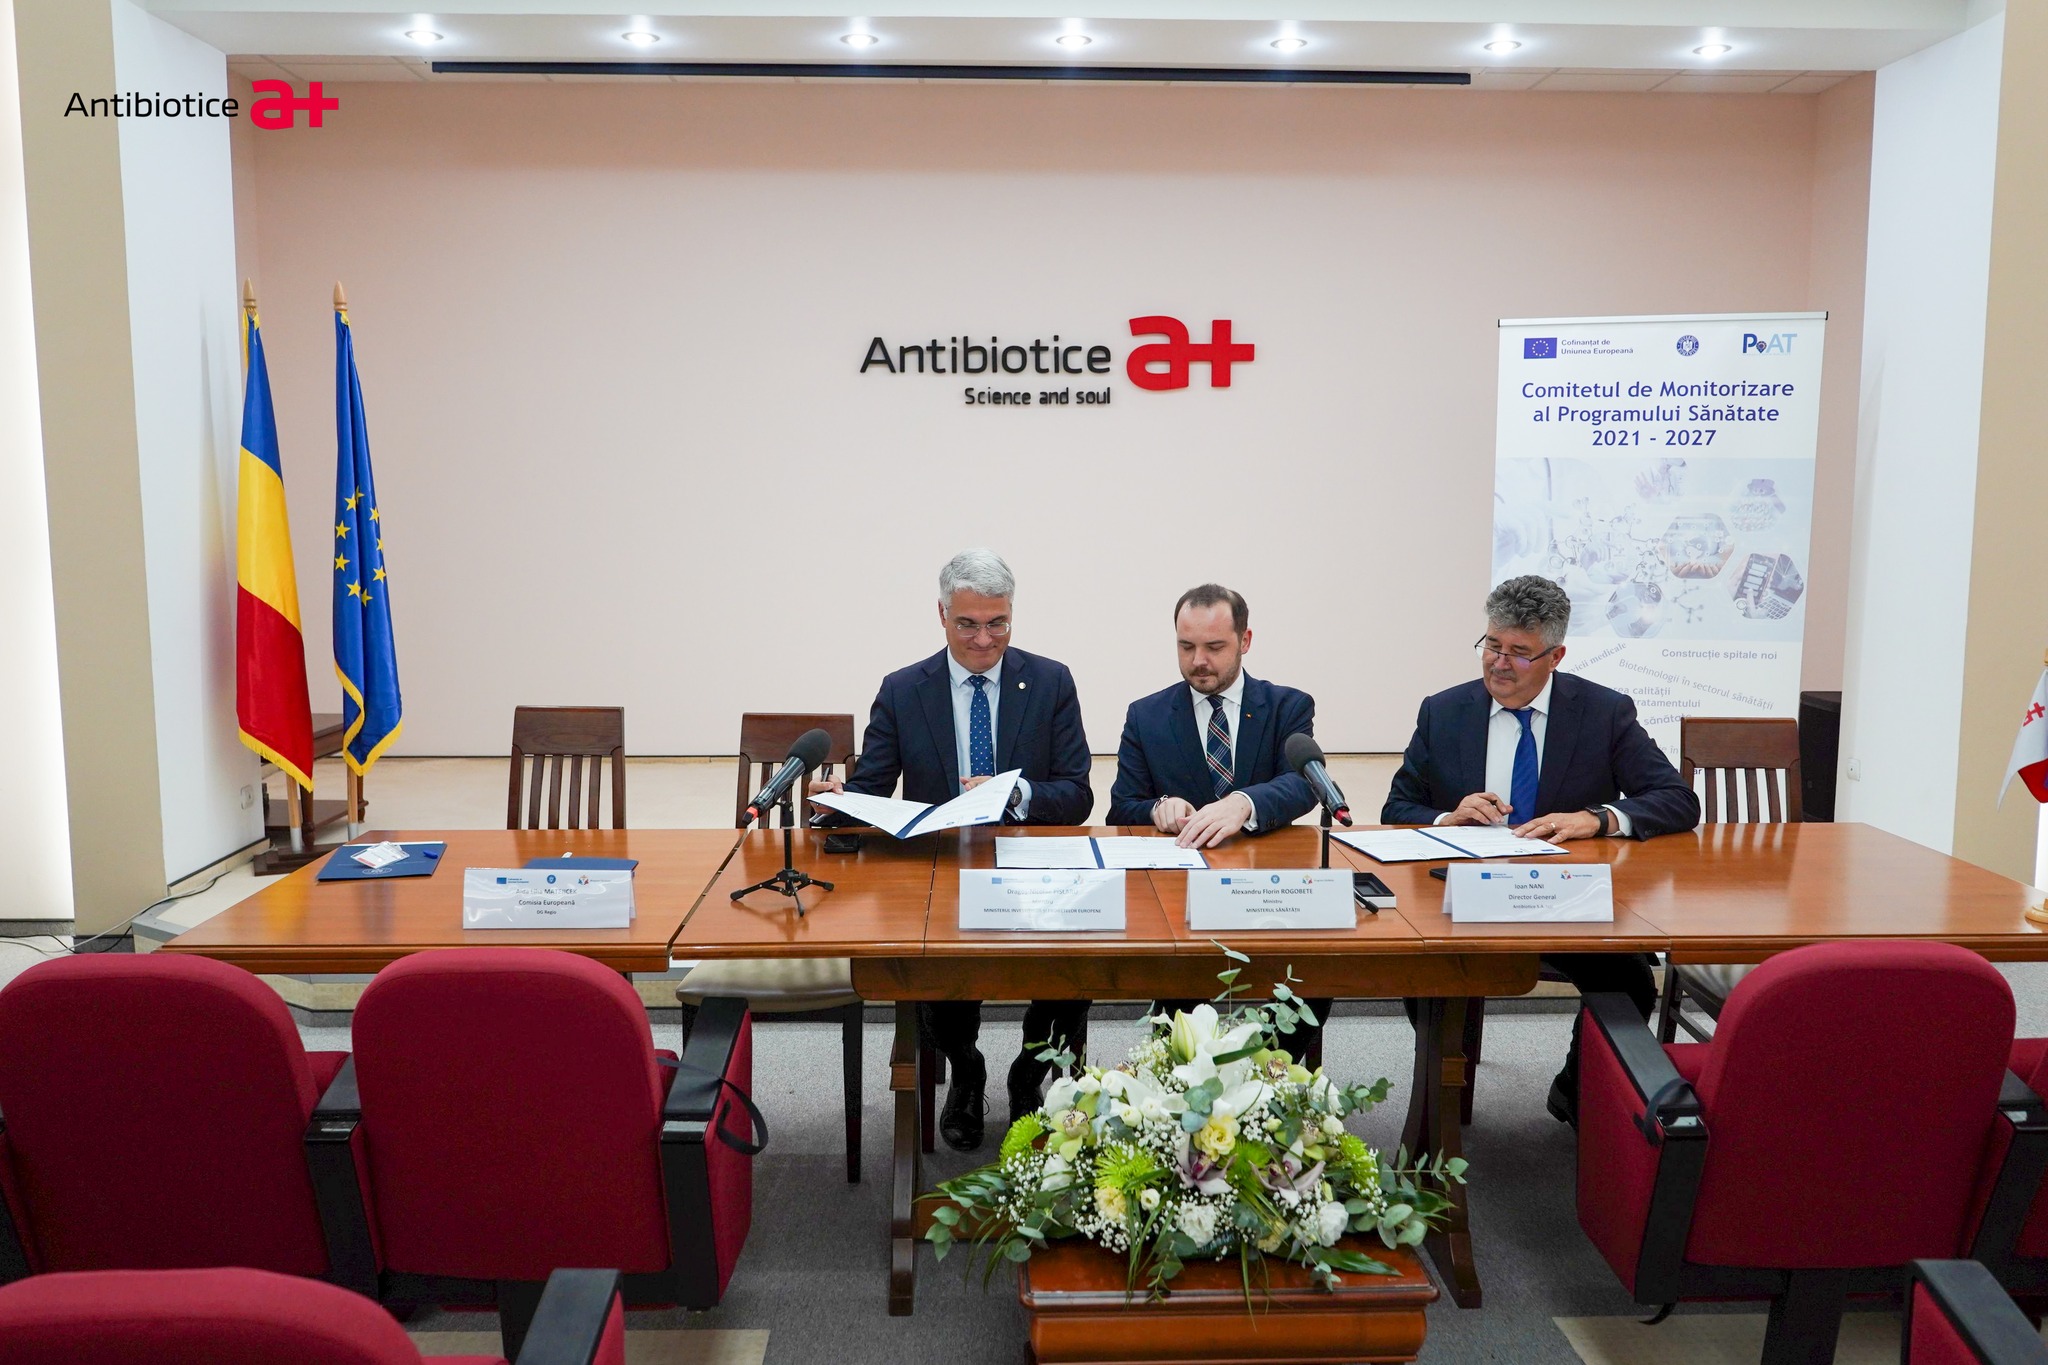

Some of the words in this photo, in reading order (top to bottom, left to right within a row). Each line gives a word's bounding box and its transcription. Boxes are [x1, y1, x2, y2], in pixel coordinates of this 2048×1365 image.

[860, 335, 1112, 374] Antibiotice
[964, 386, 1032, 406] Science
[1039, 386, 1070, 405] and
[1076, 386, 1112, 405] soul
[1522, 381, 1620, 398] Comitetul
[1628, 381, 1653, 397] de
[1659, 380, 1795, 397] Monitorizare
[1533, 406, 1550, 422] al
[1558, 405, 1681, 426] Programului
[1688, 404, 1780, 422] Sănătate
[1592, 430, 1640, 446] 2021
[1665, 429, 1717, 446] 2027
[1589, 641, 1628, 664] medicale
[1723, 650, 1758, 660] spitale
[1760, 651, 1778, 660] noi
[1618, 658, 1680, 684] Biotehnologii
[1681, 675, 1691, 687] în
[1692, 680, 1731, 699] sectorul
[543, 899, 576, 907] Europeană
